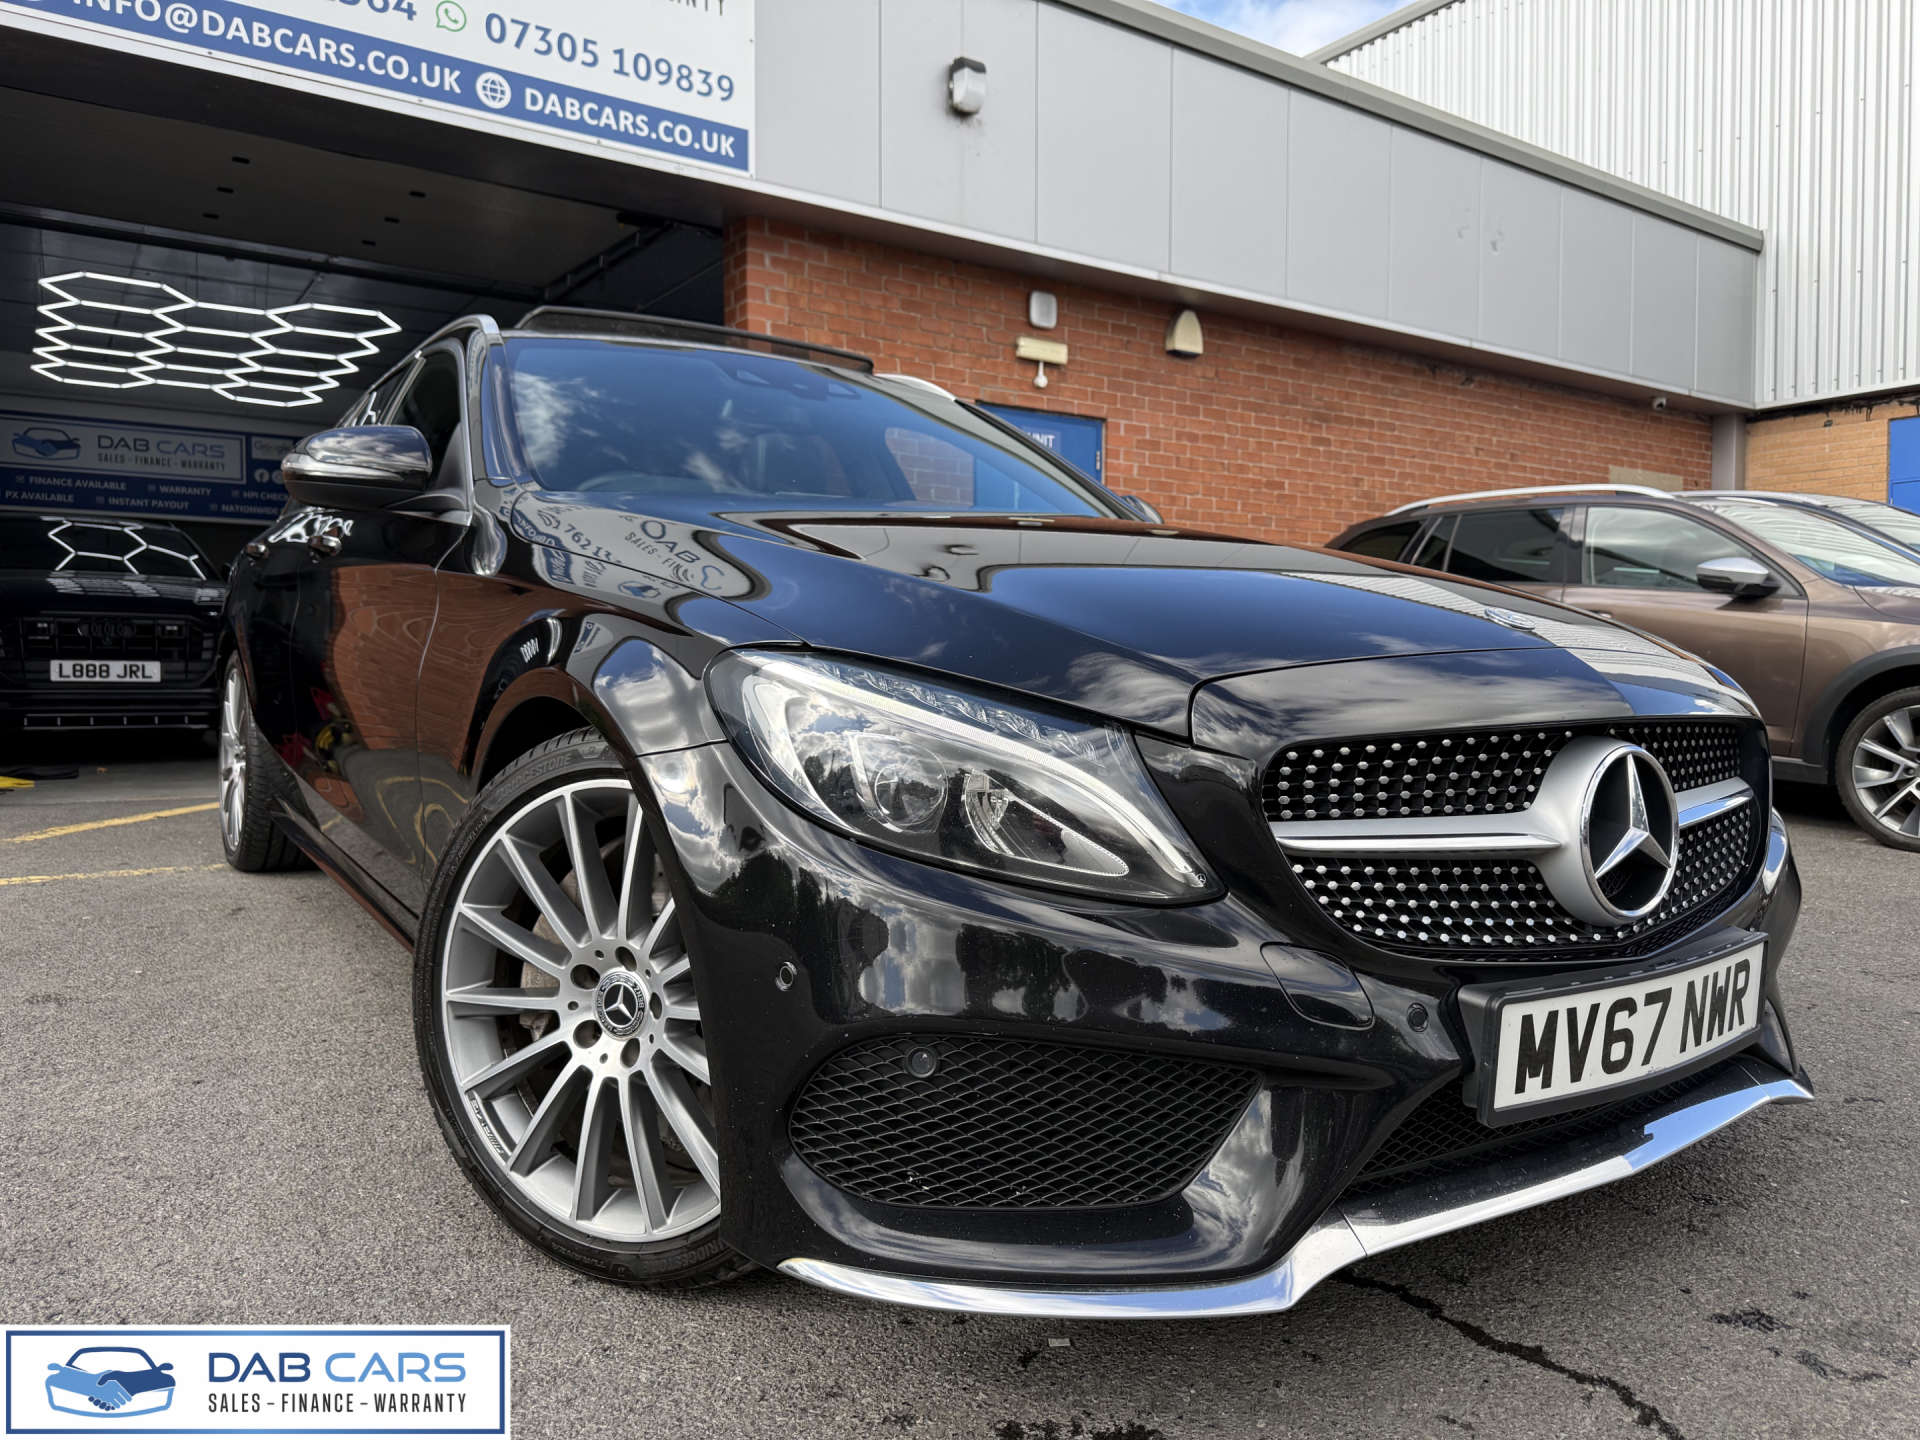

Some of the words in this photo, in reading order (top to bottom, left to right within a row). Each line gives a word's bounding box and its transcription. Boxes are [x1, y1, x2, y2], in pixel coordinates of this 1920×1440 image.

[73, 0, 462, 94] FO@DABCARS.CO.UK
[485, 13, 599, 68] 07305
[612, 48, 735, 101] 109839
[524, 87, 735, 158] DABCARS.CO.UK
[98, 435, 150, 451] DAB
[157, 440, 225, 458] CARS
[97, 452, 126, 465] SALES
[134, 456, 172, 469] FINANCE
[180, 459, 226, 472] WARRANTY
[29, 476, 72, 488] FINANCE
[75, 479, 127, 491] AVAILABLE
[160, 485, 212, 496] WARRANTY
[5, 491, 18, 500] PX
[19, 492, 74, 503] AVAILABLE
[109, 496, 148, 506] INSTANT
[152, 499, 189, 510] PAYOUT
[117, 663, 152, 679] JRL
[1515, 986, 1672, 1095] MV67
[1679, 958, 1751, 1054] NWR
